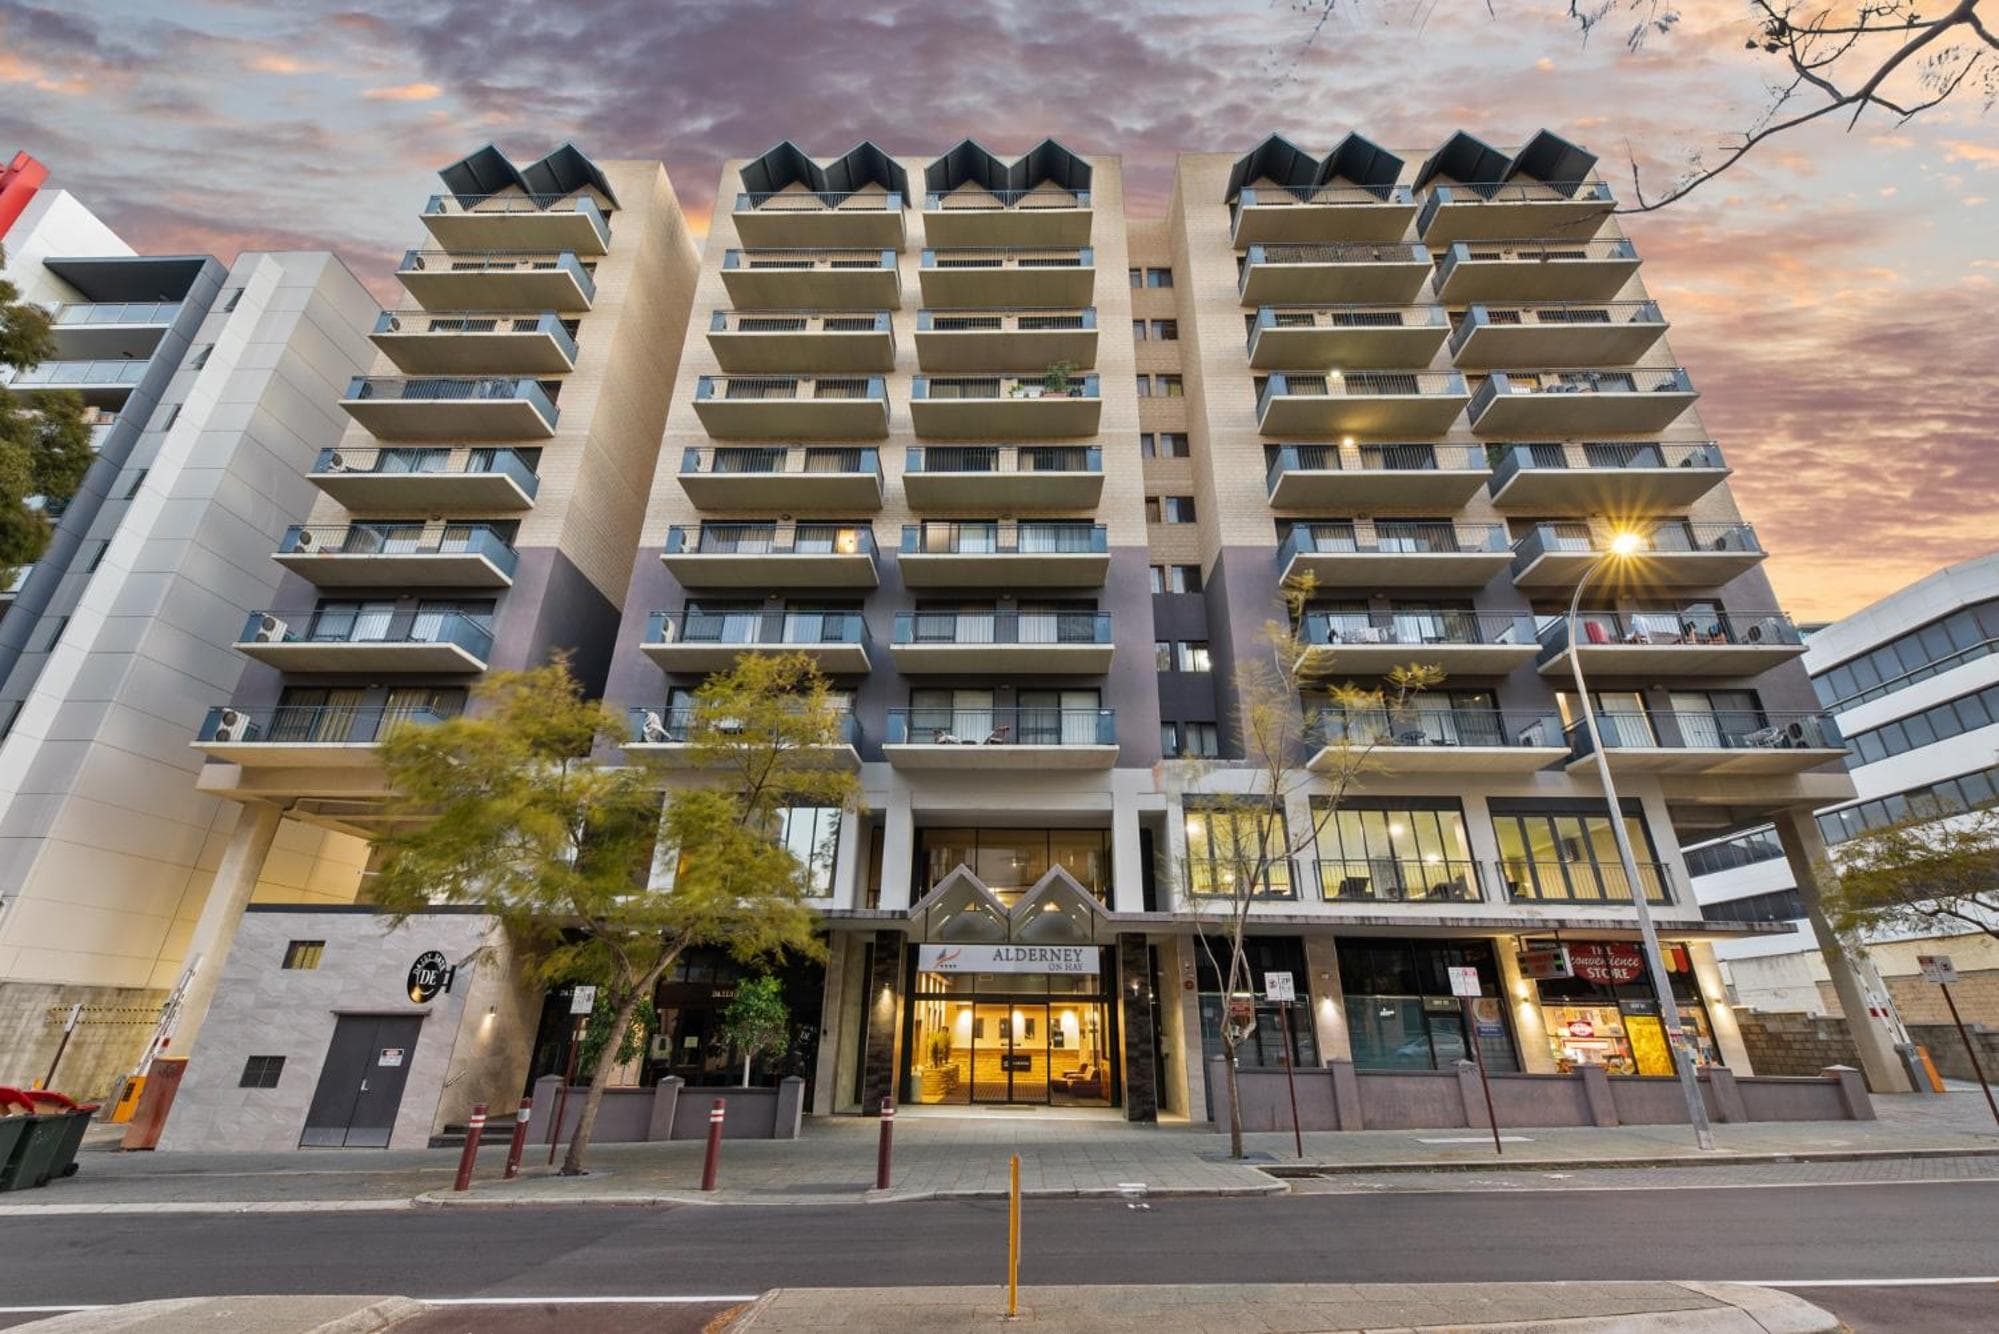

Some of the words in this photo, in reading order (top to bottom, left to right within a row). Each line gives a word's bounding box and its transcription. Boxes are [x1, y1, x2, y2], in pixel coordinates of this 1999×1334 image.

[992, 947, 1084, 962] ALDERNEY
[1048, 963, 1063, 971] ON
[1065, 963, 1084, 971] HAY
[1586, 966, 1631, 979] STORE
[419, 969, 438, 985] DE
